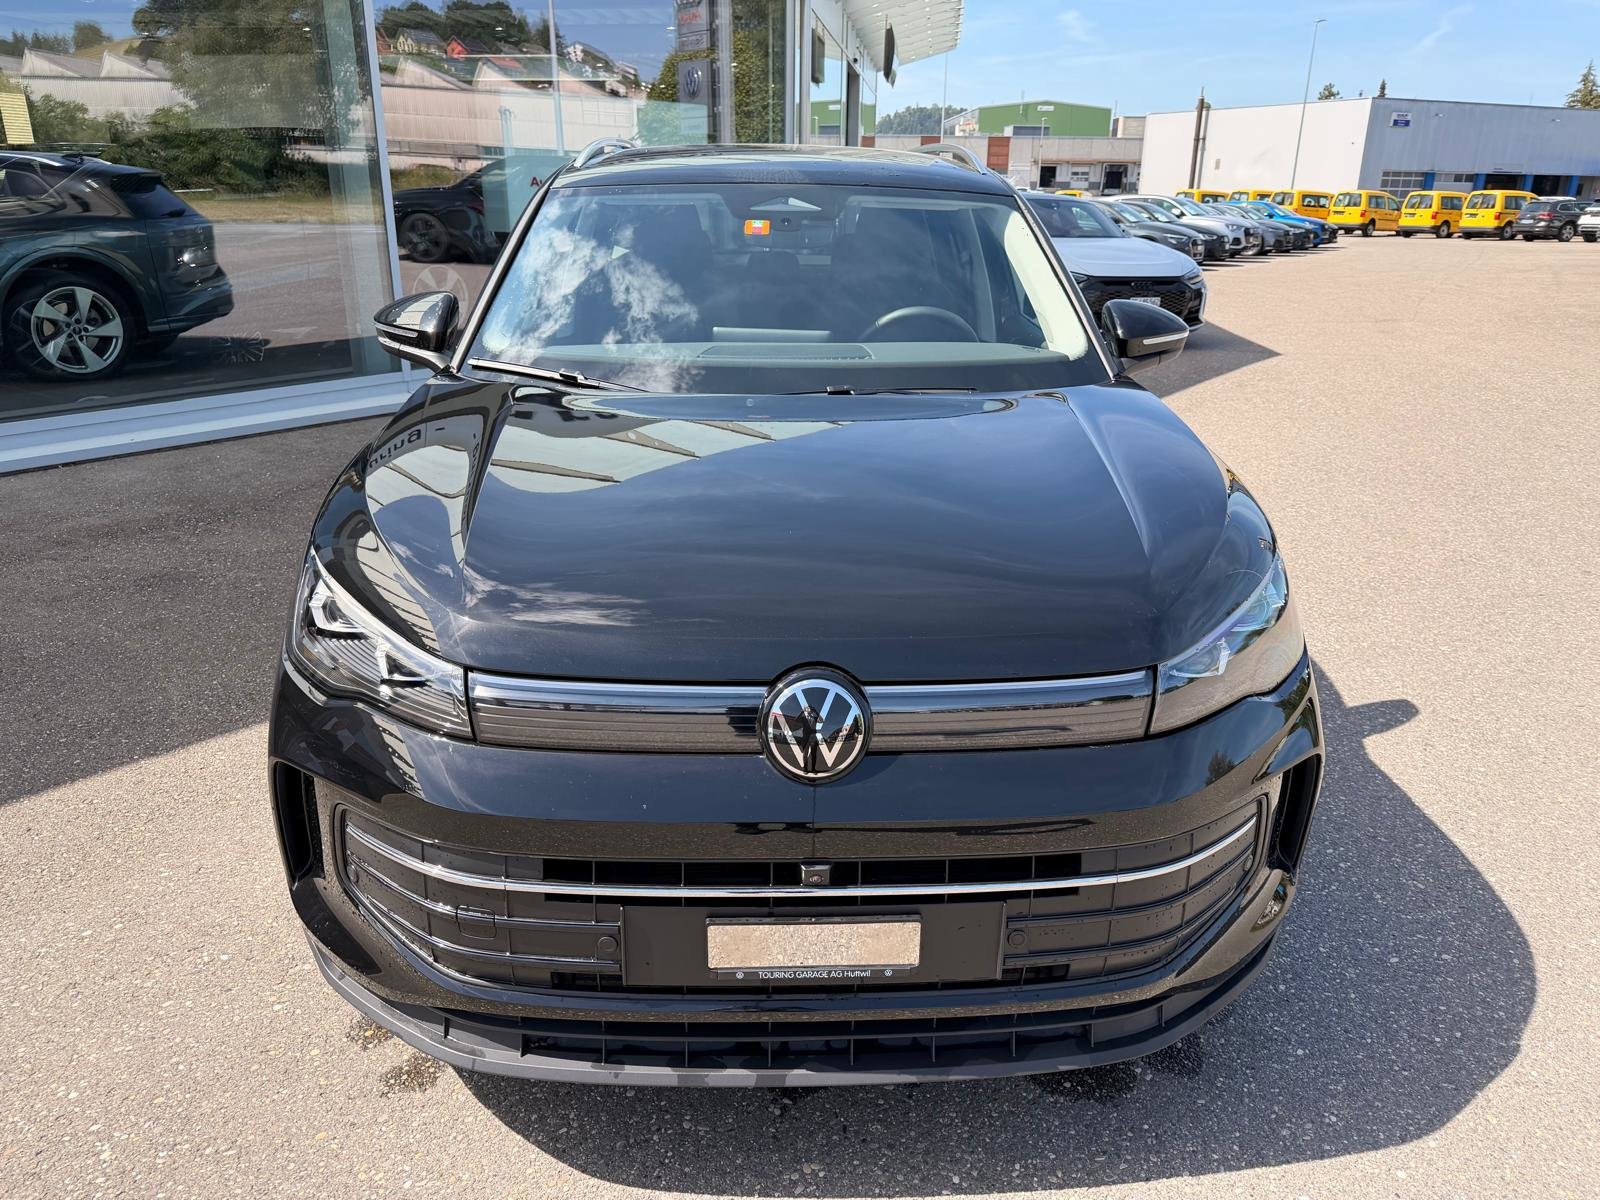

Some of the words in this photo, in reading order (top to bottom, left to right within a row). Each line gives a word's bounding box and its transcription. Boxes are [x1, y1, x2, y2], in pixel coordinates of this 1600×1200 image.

[758, 971, 794, 979] TOURING
[830, 970, 843, 978] AG
[844, 970, 871, 978] Huttwil
